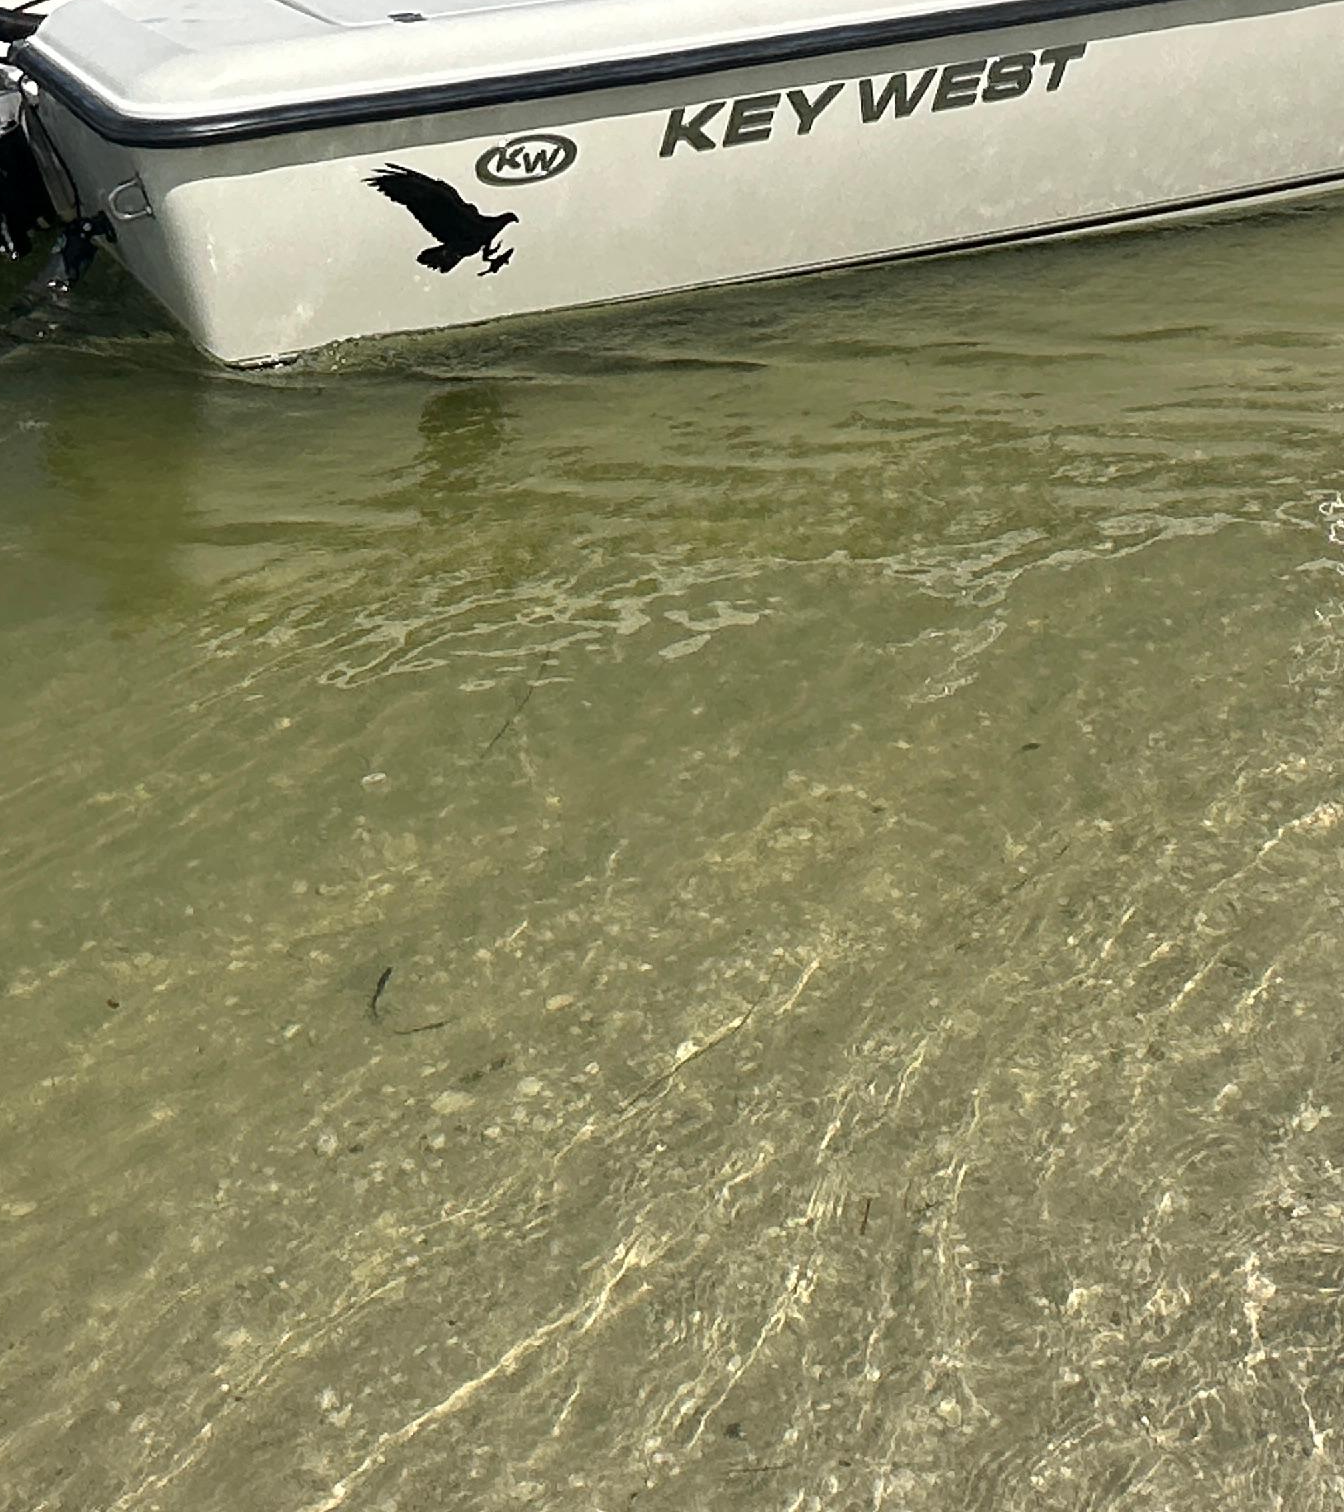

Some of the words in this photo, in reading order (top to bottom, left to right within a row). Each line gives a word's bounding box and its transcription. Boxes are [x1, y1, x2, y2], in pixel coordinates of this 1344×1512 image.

[659, 84, 844, 157] KEY
[858, 43, 1086, 124] WEST
[494, 144, 561, 175] KW
